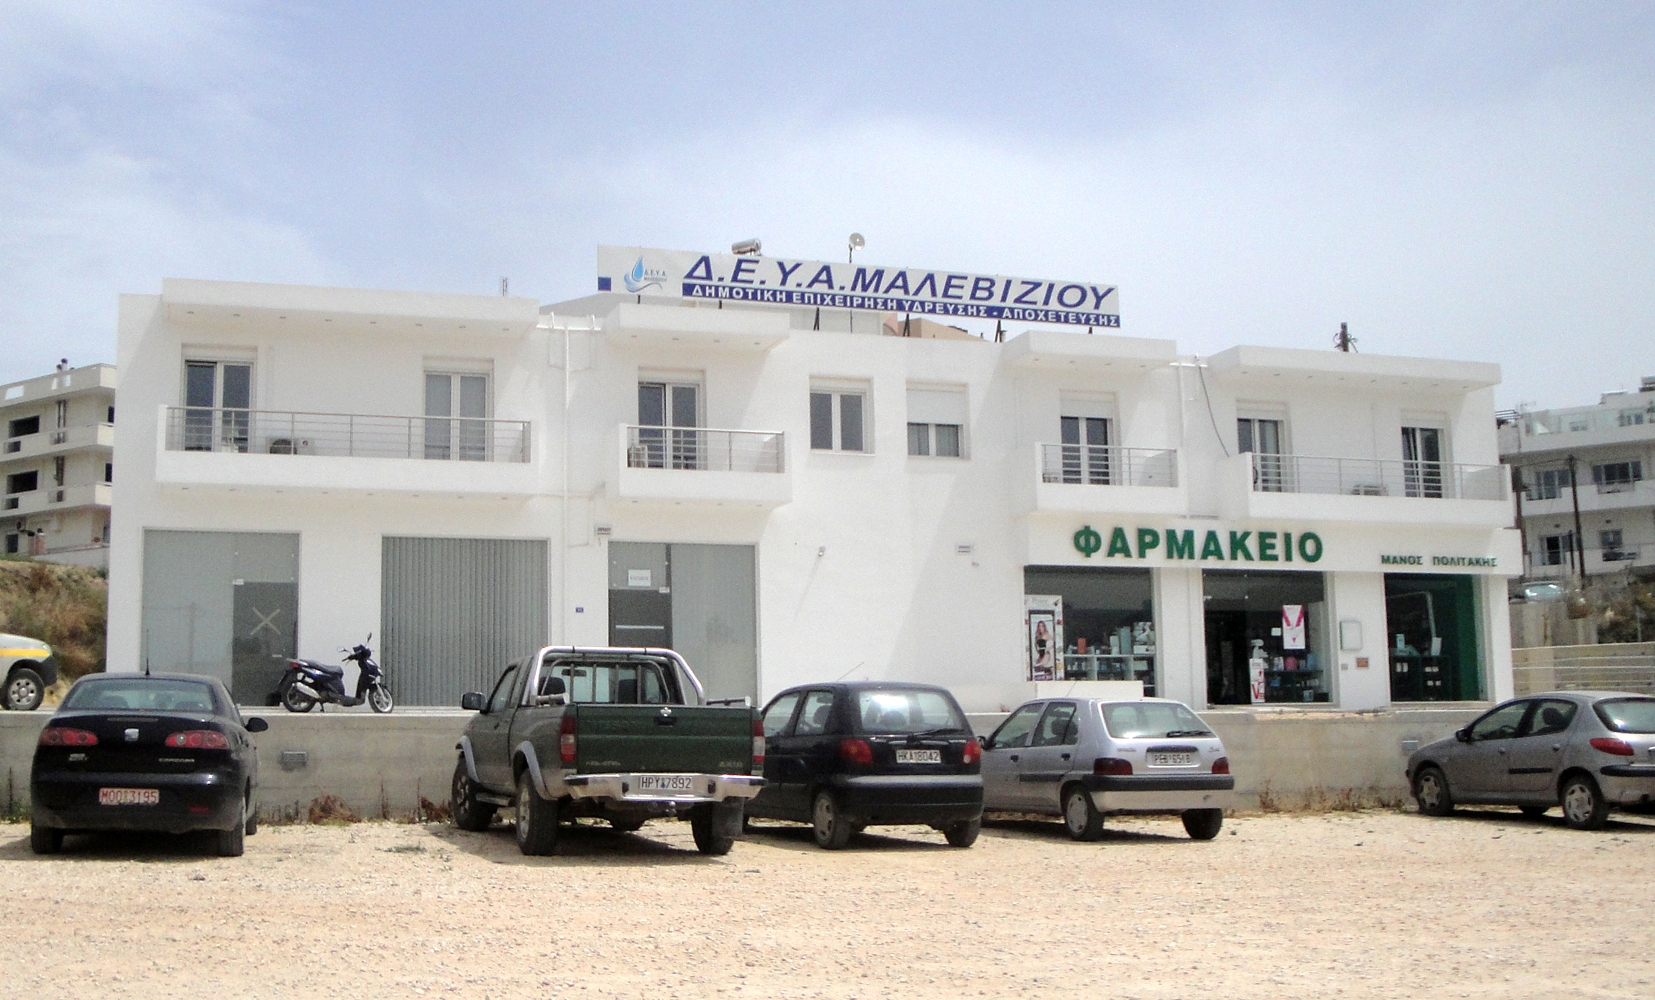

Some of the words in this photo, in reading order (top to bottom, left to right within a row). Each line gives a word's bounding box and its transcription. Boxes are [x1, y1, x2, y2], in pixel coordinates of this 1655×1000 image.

[692, 285, 786, 303] ΔΗΜΟΤΙΚΗ
[792, 293, 898, 310] ΕΠΙΧΕΙΡΗΣΗ
[902, 301, 987, 317] ΥΔΡΕΥΣΗΣ
[1002, 309, 1119, 327] ΑΠΟΧΕΤΕΥΣΗΣ
[1073, 525, 1323, 563] ΦΑΡΜΑΚΕΙΟ
[1381, 555, 1423, 566] ΜΑΝΟΣ
[1433, 556, 1498, 567] ΠΟΛΙΤΑΚΗΣ
[666, 778, 692, 789] 7892
